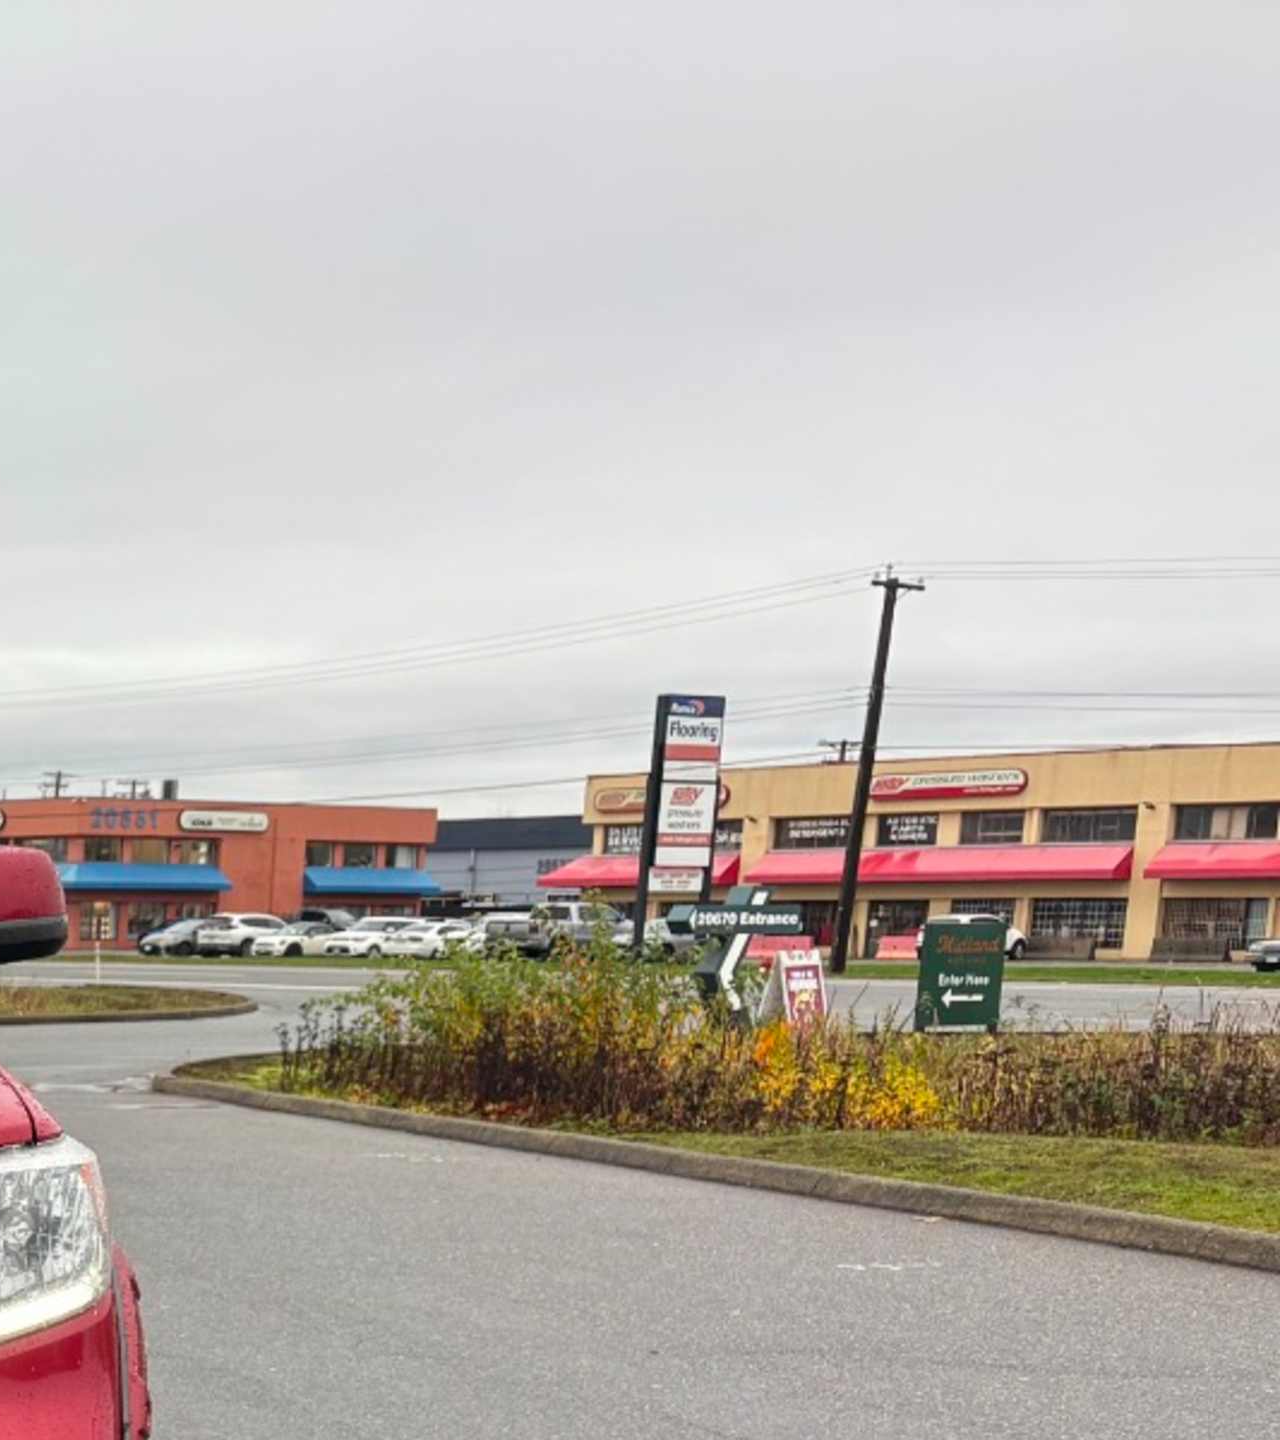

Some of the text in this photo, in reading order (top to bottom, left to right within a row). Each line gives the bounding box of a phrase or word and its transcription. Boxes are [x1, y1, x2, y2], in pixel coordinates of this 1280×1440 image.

[669, 720, 719, 742] Flooring
[697, 912, 799, 925] 20670 Entrance
[938, 973, 964, 987] Enter
